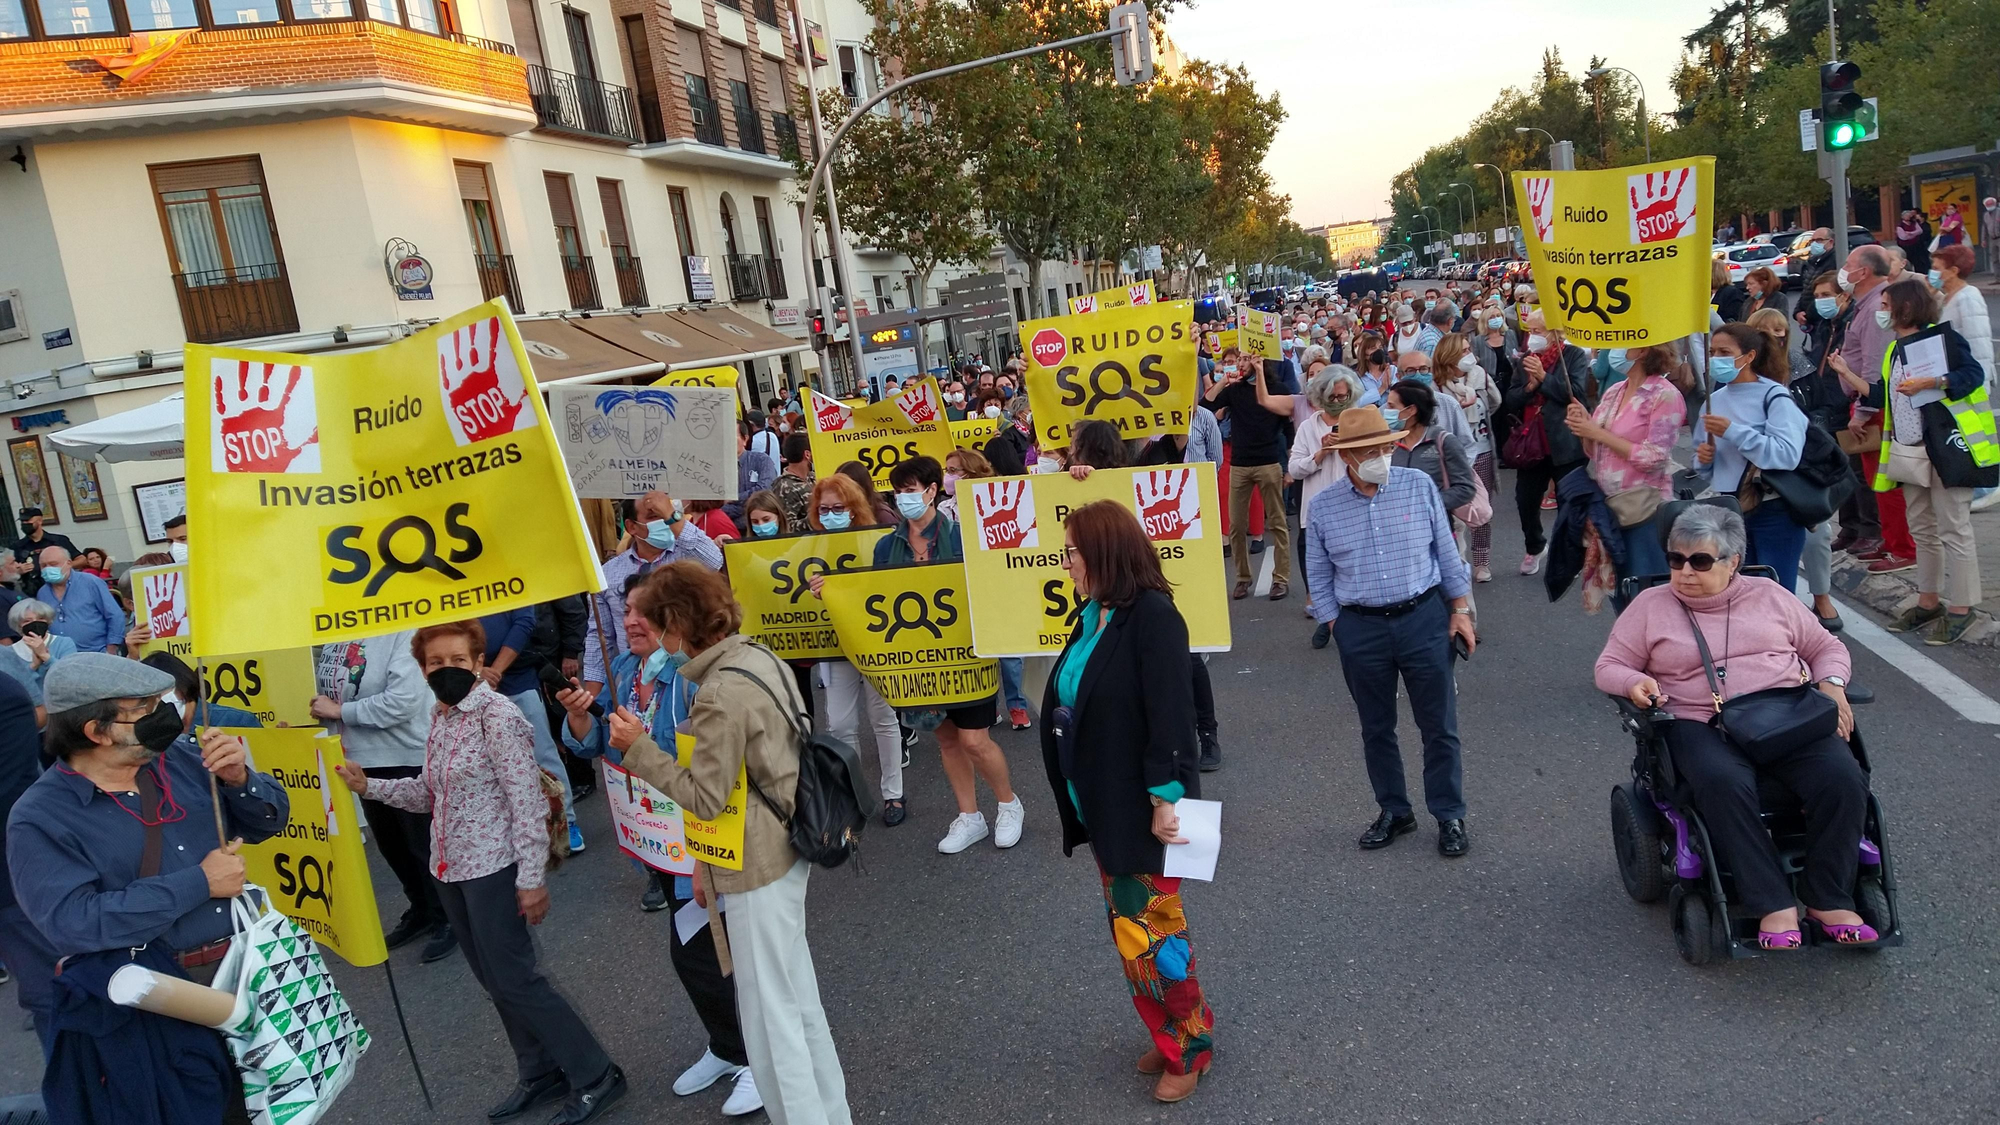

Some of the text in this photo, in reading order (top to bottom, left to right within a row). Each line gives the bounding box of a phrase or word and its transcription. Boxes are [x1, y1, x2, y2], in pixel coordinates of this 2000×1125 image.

[1564, 206, 1608, 223] Ruido
[1638, 210, 1676, 239] STOP
[1589, 245, 1678, 265] terrazas
[1104, 300, 1125, 309] Ruido
[1556, 275, 1631, 325] SOS
[1035, 322, 1183, 355] STOP RUIDOS
[1248, 337, 1265, 352] SOS
[1596, 328, 1649, 341] RETIRO
[1056, 354, 1170, 416] SOS
[353, 396, 422, 434] Ruido
[455, 387, 505, 436] STOP
[820, 413, 840, 430] STOP
[911, 405, 931, 422] STOP
[1047, 406, 1192, 440] CHMBERÍ
[224, 427, 283, 466] STOP
[833, 427, 887, 443] Invasión
[570, 449, 598, 480] LOVE
[608, 458, 668, 471] ALMEIDA
[679, 452, 713, 474] HATE
[858, 442, 920, 477] SOS
[258, 442, 523, 507] Invasión terrazas
[632, 482, 656, 492] MAN
[986, 520, 1018, 545] STOP
[1146, 510, 1179, 537] STOP
[326, 502, 483, 597] SOS
[315, 576, 525, 632] DISTRITO RETIRO
[865, 588, 958, 644] SOS
[152, 611, 175, 635] STOP
[761, 610, 818, 625] MADRID
[786, 632, 800, 651] EN
[800, 629, 839, 650] PELIGRO
[856, 651, 913, 667] MADRID
[889, 675, 901, 699] IN
[902, 671, 939, 699] DANGER
[940, 670, 951, 696] OF
[690, 820, 703, 831] NO
[705, 825, 718, 835] así
